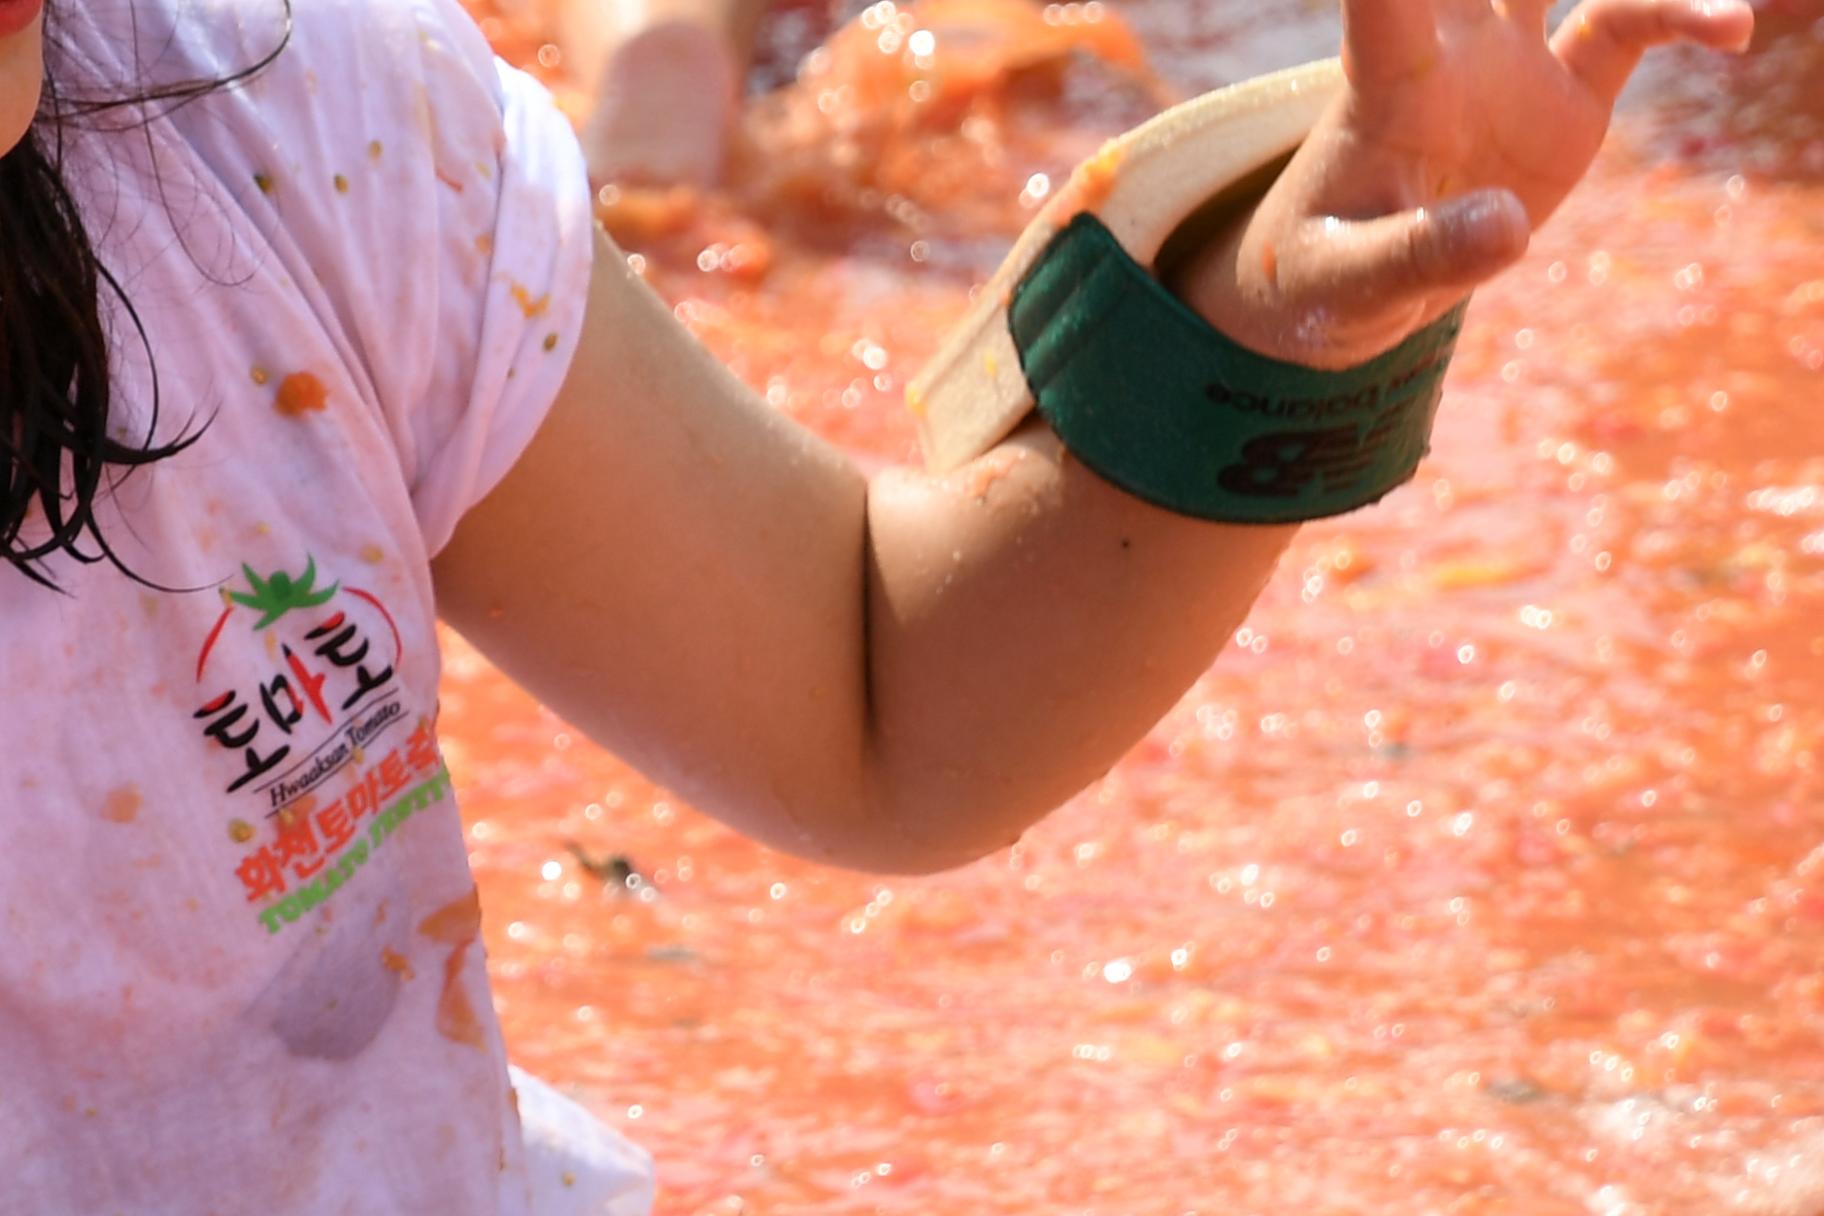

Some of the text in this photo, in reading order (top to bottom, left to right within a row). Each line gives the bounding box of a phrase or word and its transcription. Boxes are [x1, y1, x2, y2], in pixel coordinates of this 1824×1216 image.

[1205, 384, 1380, 421] balance
[192, 611, 394, 794] 토마토
[344, 701, 400, 747] Tomato
[259, 836, 370, 935] TOMATO
